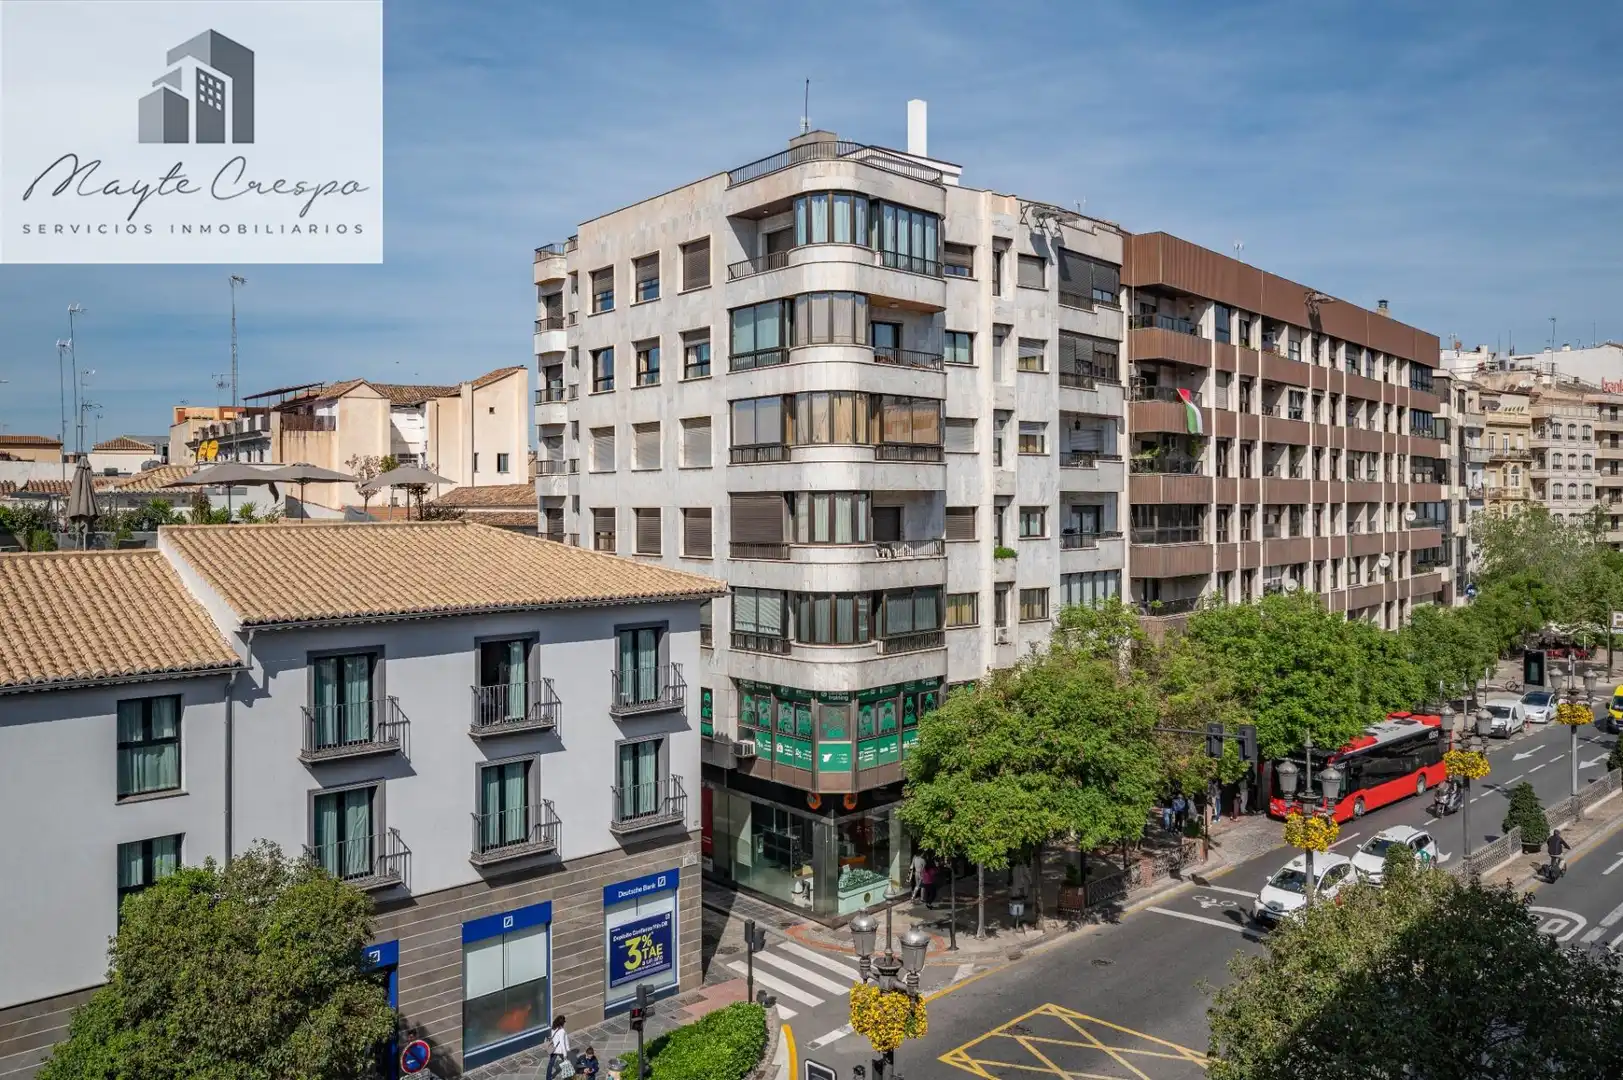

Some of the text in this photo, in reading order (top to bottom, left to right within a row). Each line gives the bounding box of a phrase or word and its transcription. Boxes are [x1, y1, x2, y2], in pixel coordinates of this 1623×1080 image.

[618, 883, 656, 898] Deutsche Bank
[641, 943, 663, 960] TAE
